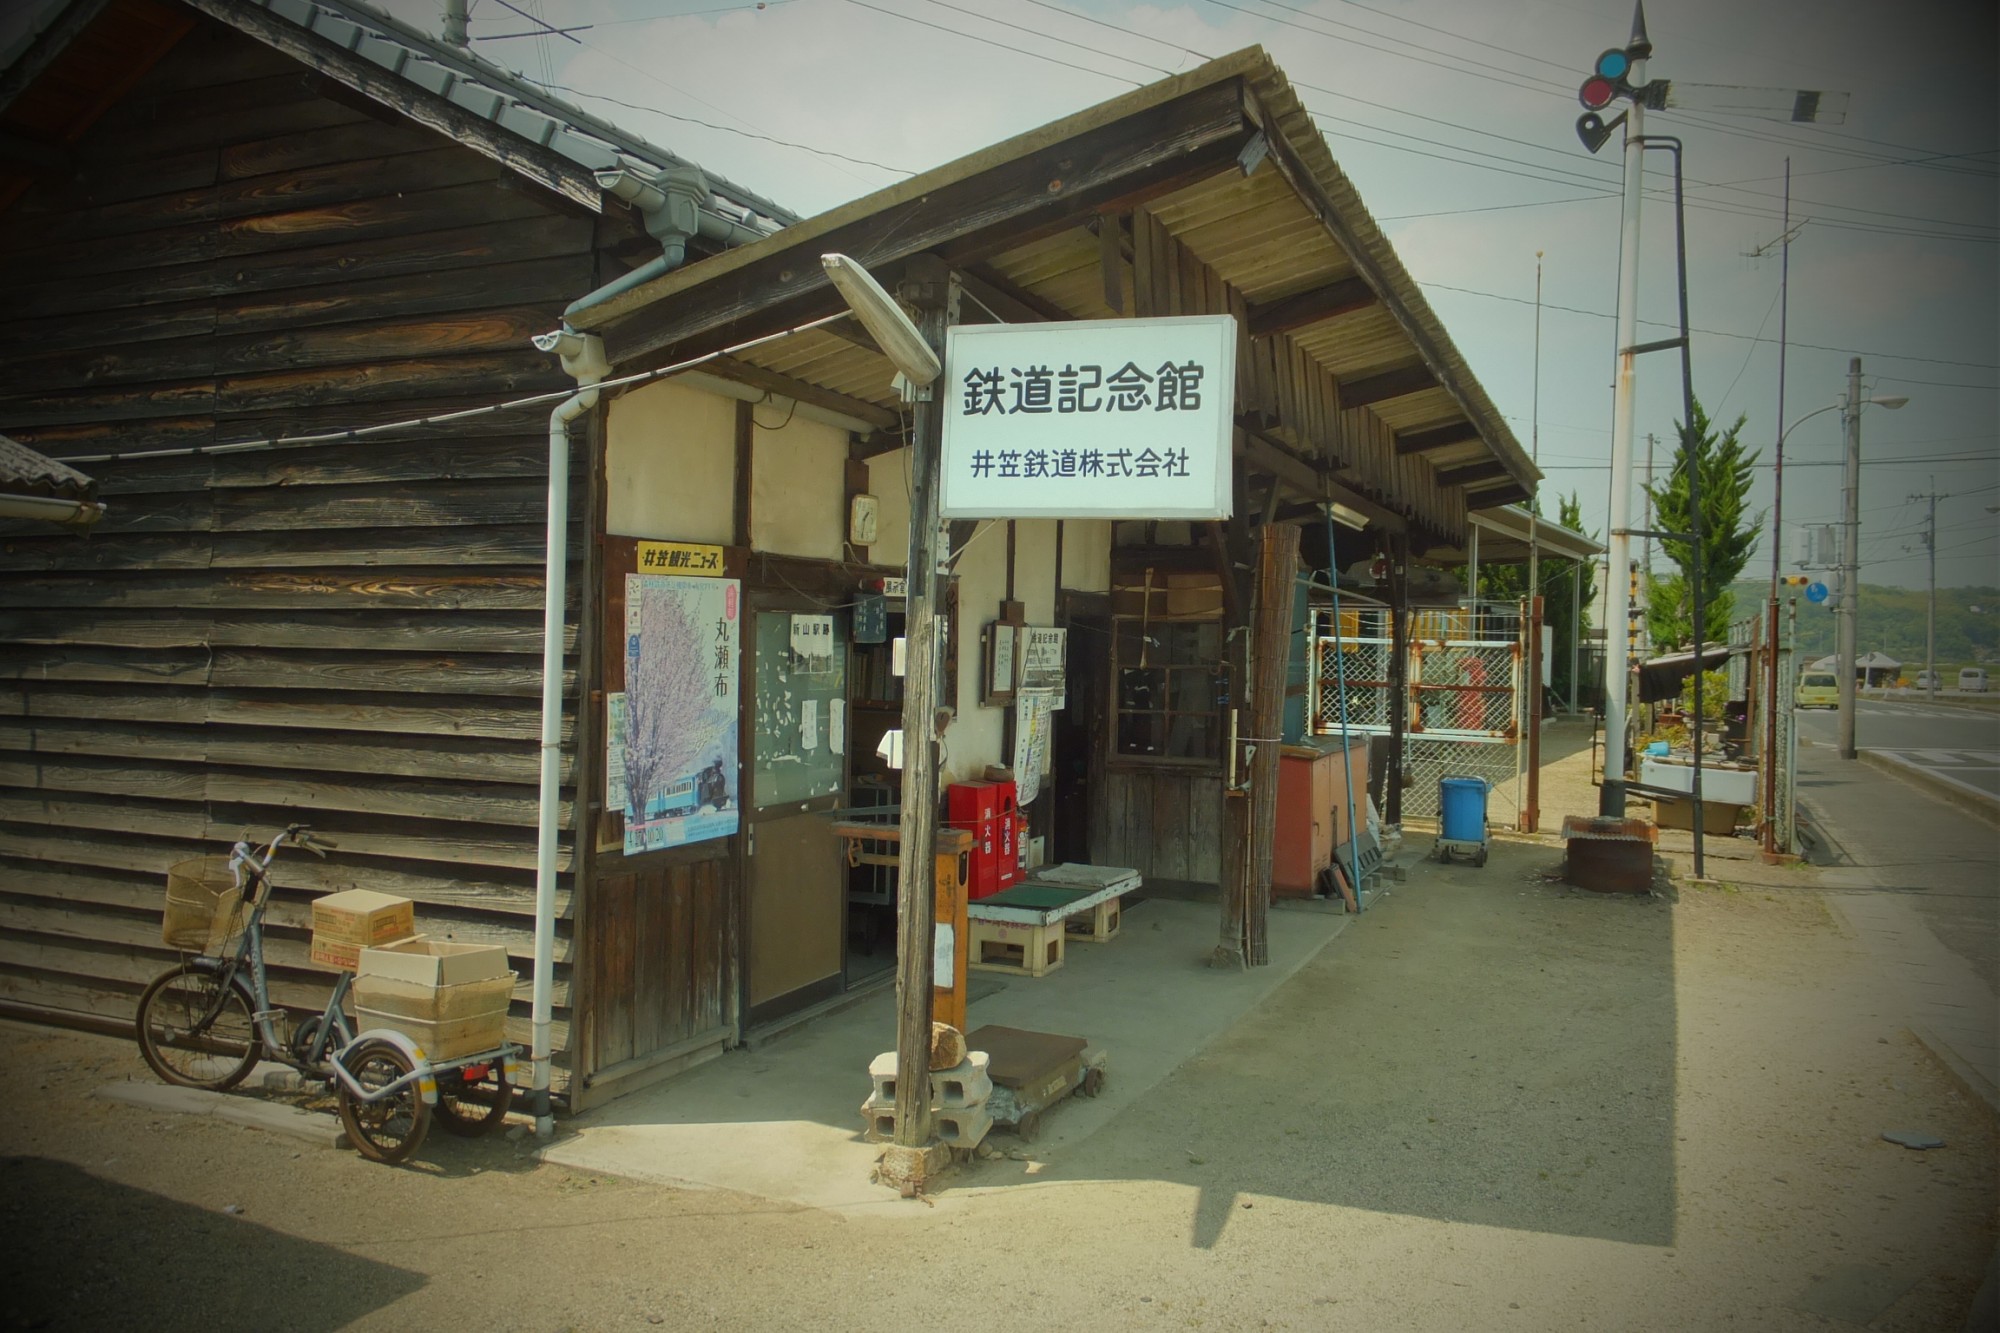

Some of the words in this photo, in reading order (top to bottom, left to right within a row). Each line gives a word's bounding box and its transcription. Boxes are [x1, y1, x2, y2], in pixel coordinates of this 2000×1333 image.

[962, 359, 1205, 416] 鉄道記念館
[970, 447, 1190, 479] 井笠鉄道株式会社
[643, 548, 719, 570] 井笠観光ニュース
[793, 622, 830, 636] 新山駅跡
[714, 616, 730, 698] 丸瀬布
[984, 807, 992, 855] 消火器
